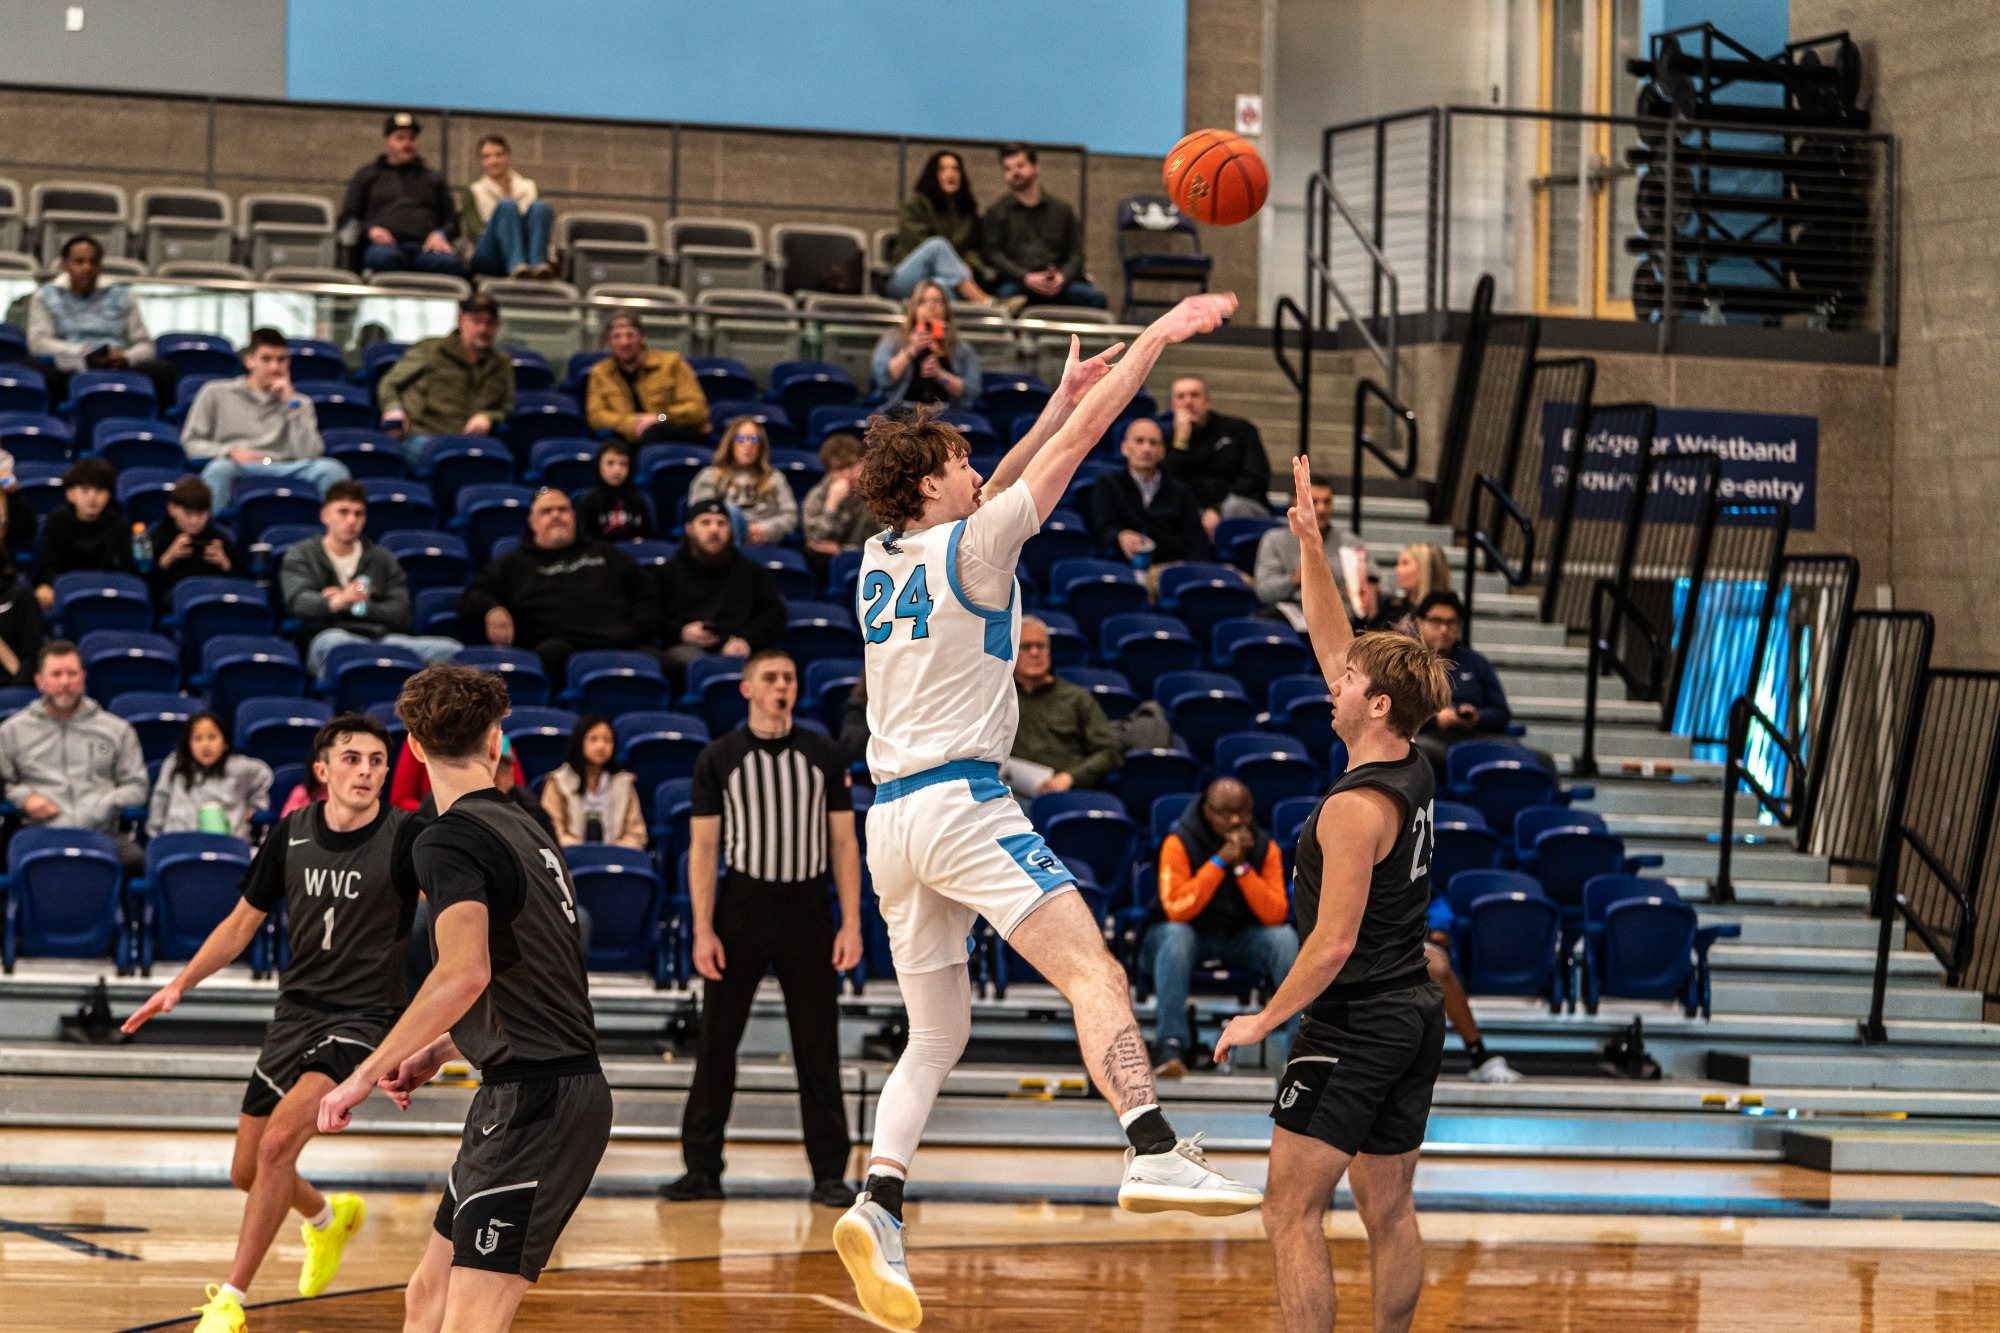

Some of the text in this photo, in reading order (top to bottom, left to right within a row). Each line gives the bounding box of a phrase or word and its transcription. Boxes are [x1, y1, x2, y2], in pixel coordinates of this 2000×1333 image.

[1674, 433, 1798, 463] Wristband
[1551, 464, 1660, 495] Rquird
[862, 563, 934, 645] 24
[304, 867, 362, 899] WVC
[321, 906, 335, 950] 1
